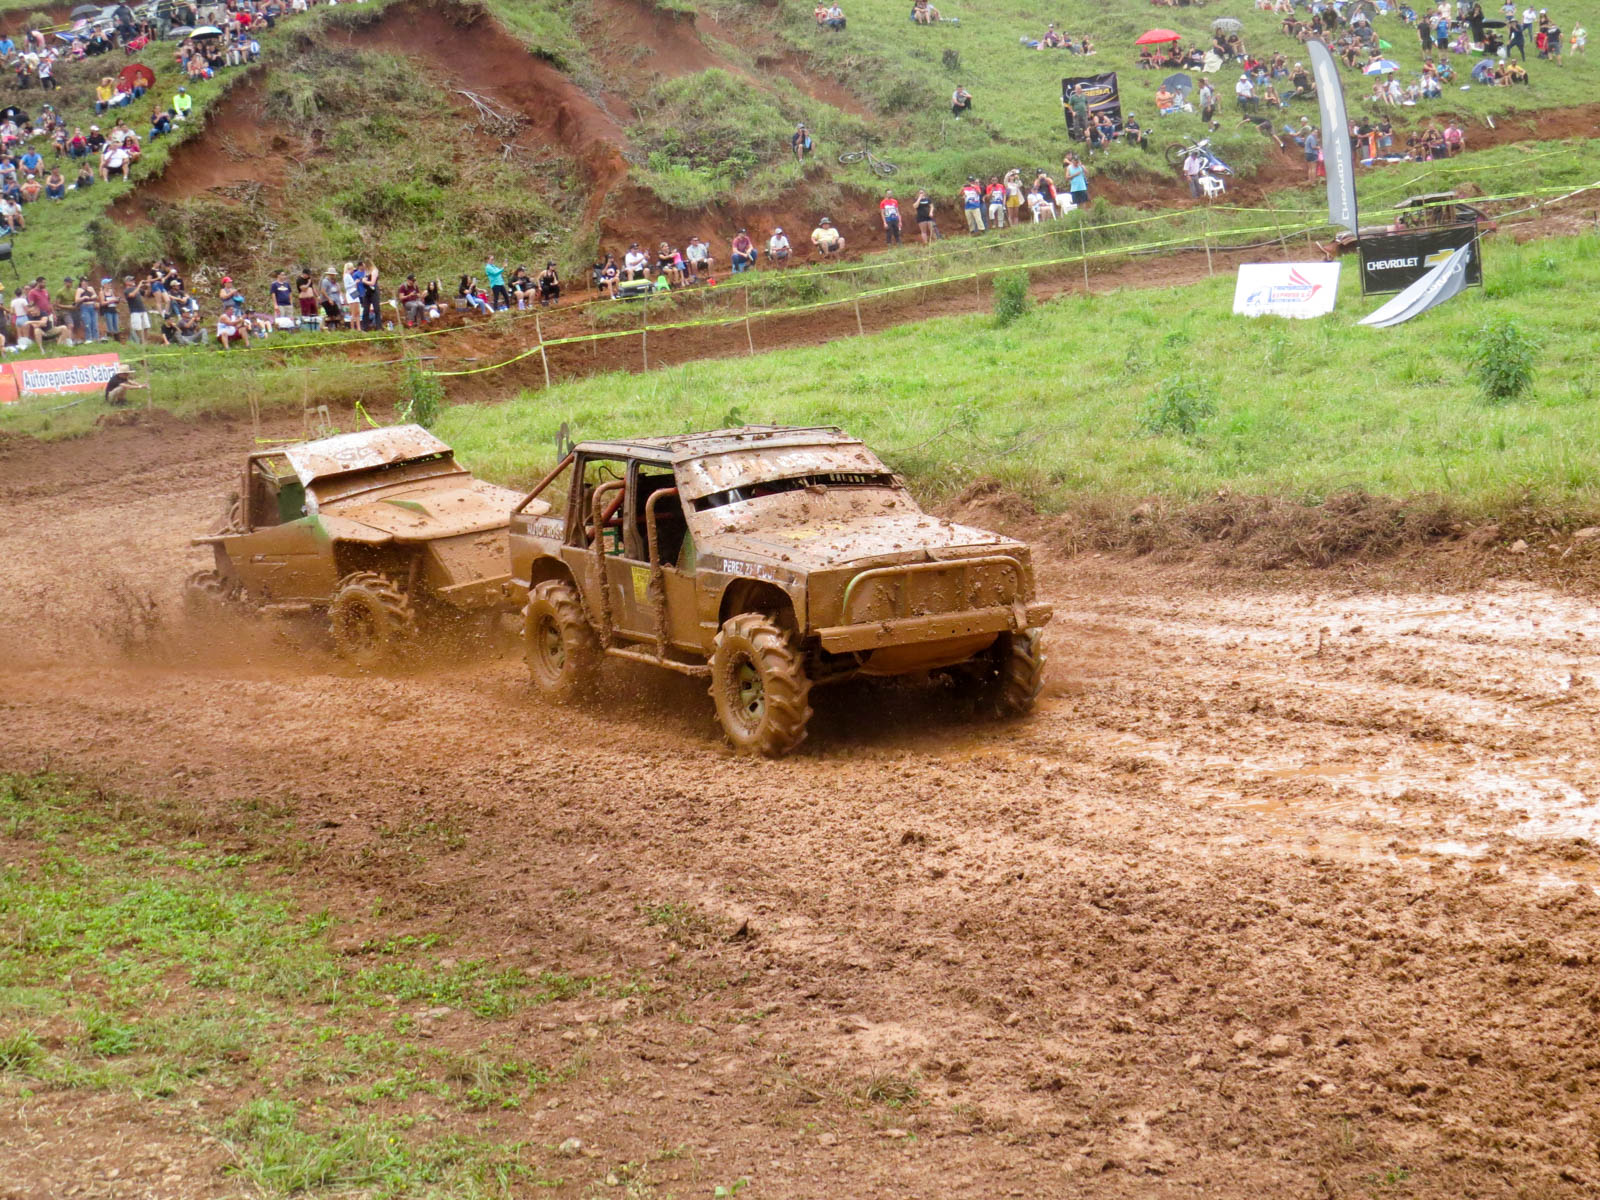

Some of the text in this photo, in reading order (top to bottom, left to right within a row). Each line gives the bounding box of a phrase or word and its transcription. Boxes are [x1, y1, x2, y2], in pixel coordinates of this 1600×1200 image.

[1367, 257, 1418, 271] CHEVROLET
[23, 366, 90, 390] Autorepuestos
[723, 559, 745, 575] PEREZ
